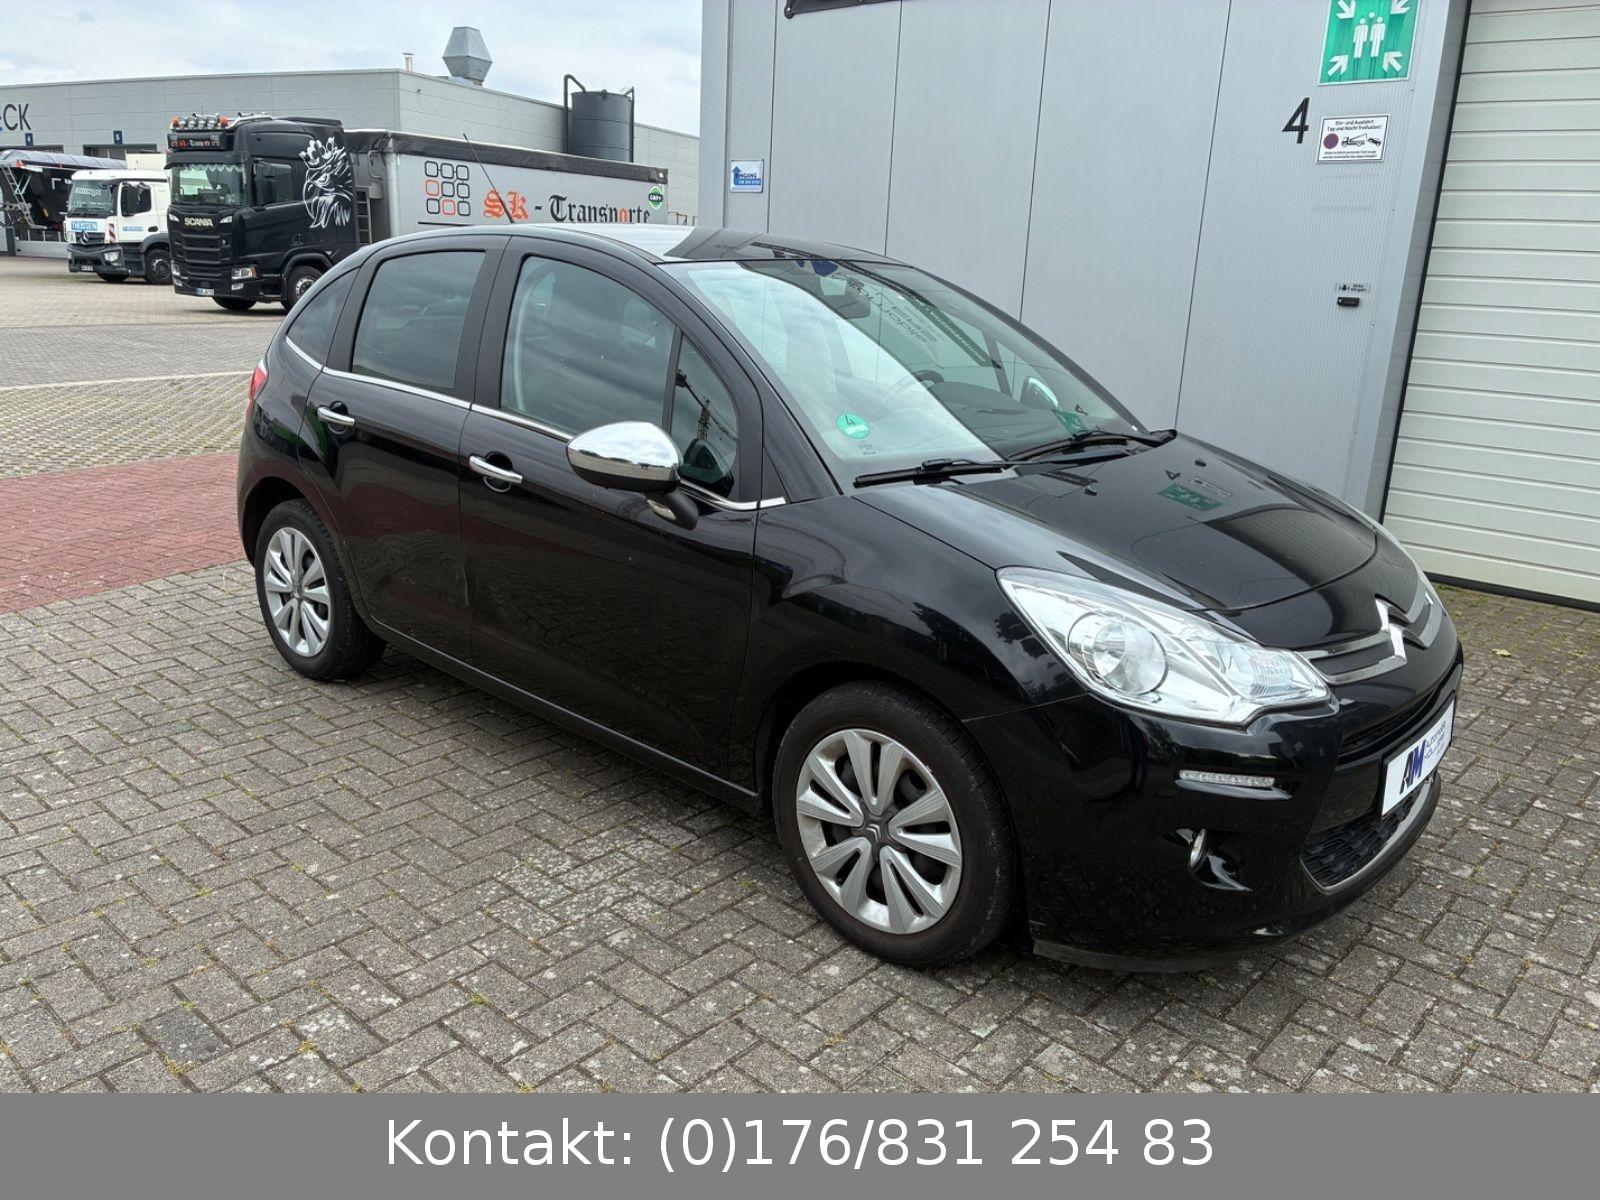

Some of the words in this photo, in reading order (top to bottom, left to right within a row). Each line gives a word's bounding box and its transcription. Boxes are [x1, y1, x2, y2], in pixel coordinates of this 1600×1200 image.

[0, 103, 32, 131] CK
[1282, 96, 1311, 144] 4
[184, 217, 213, 227] SCANIA
